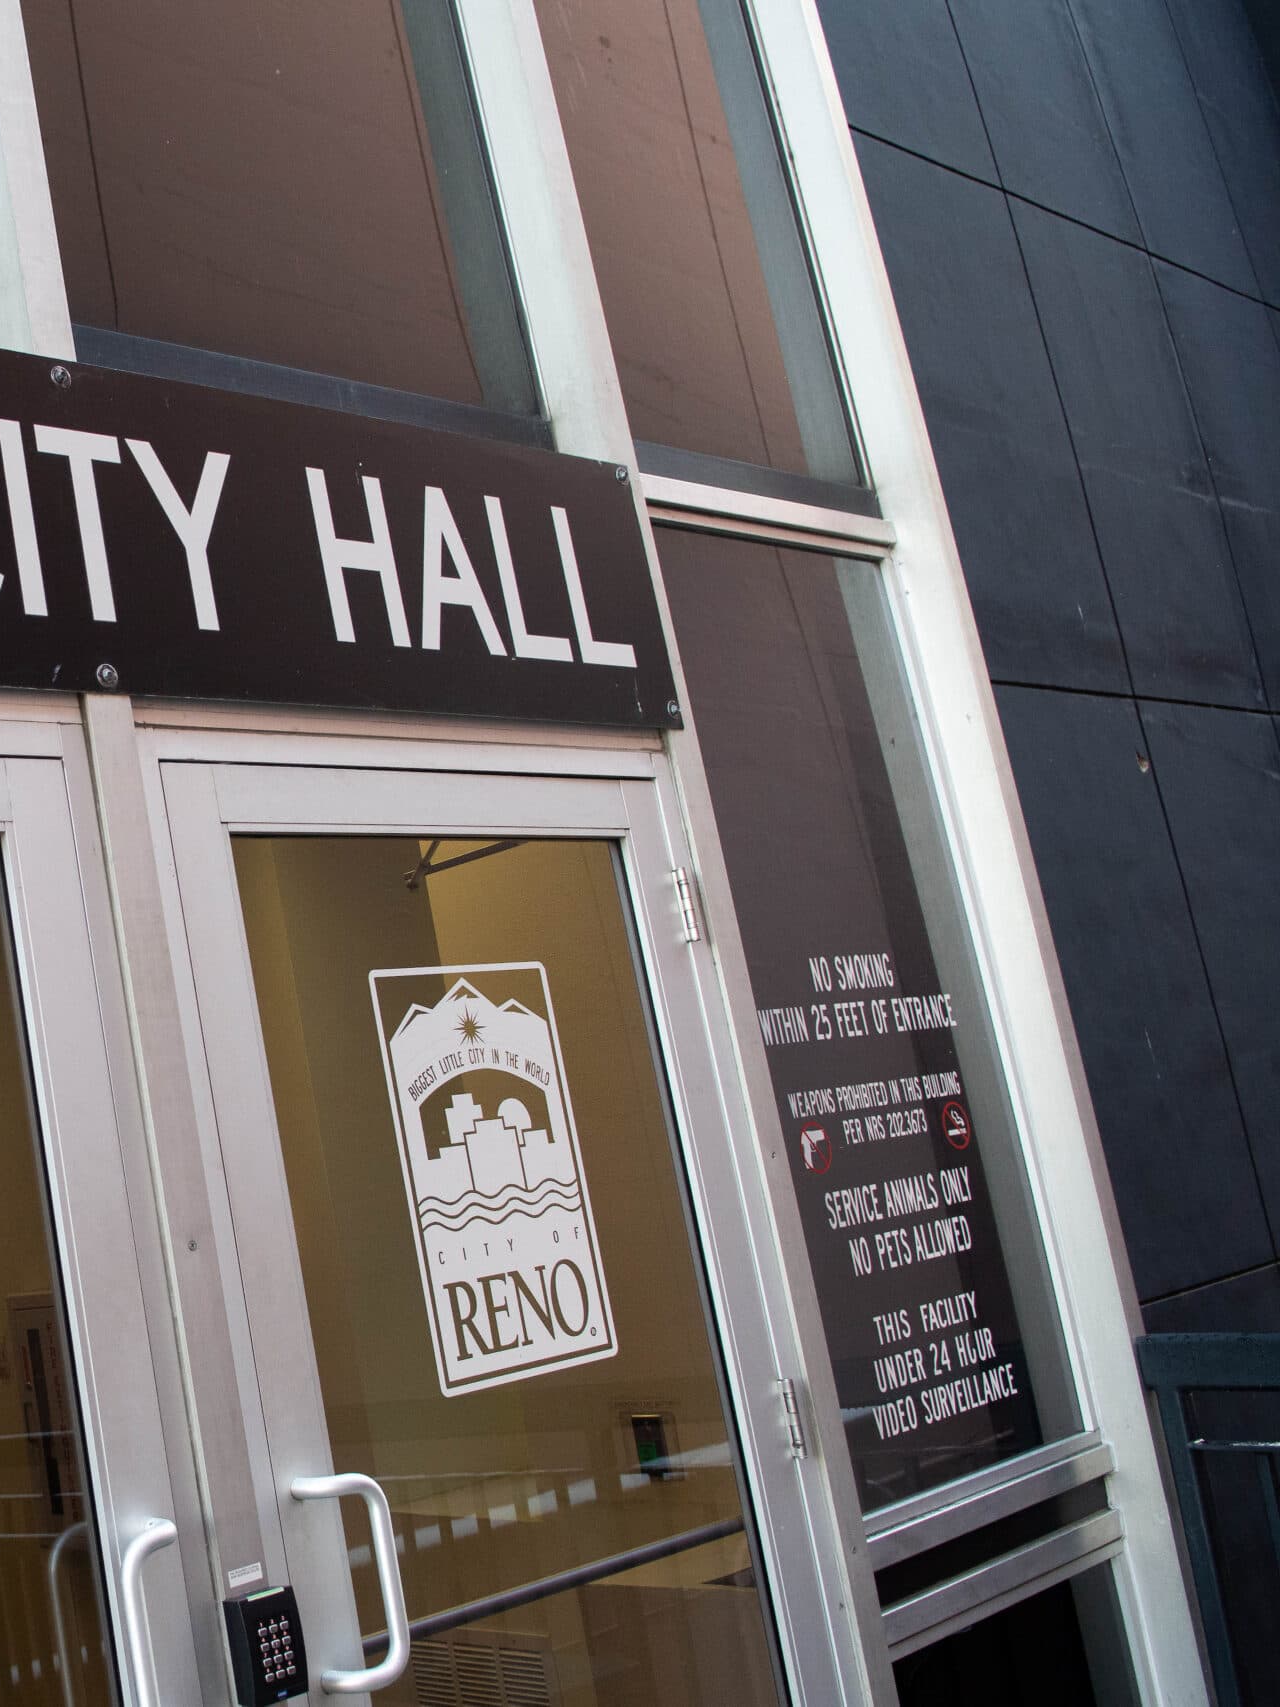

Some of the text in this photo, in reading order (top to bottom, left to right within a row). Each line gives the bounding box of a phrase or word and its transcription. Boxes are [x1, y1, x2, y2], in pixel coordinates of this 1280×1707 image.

[305, 467, 636, 667] HALL
[808, 953, 894, 992] NO SMOKING
[758, 994, 958, 1046] WITHIN 25 FEET OF ENTRANCE
[407, 1048, 550, 1102] BIGGEST LITTLE CITY IN THE WORLD
[787, 1071, 961, 1119] WEAPONS PROHIBITED IN THIS BUILDING
[842, 1118, 865, 1145] PER
[865, 1115, 886, 1141] NRS
[824, 1166, 972, 1230] SERVICE ANIMALS ONLY
[438, 1226, 579, 1265] CITY OF
[848, 1215, 972, 1277] NO PETS ALLOWED
[872, 1290, 977, 1345] THIS FACILITY
[873, 1348, 927, 1393] UNDER
[929, 1340, 952, 1376] 24
[872, 1363, 1018, 1440] VIDEO SURVEILLANCE
